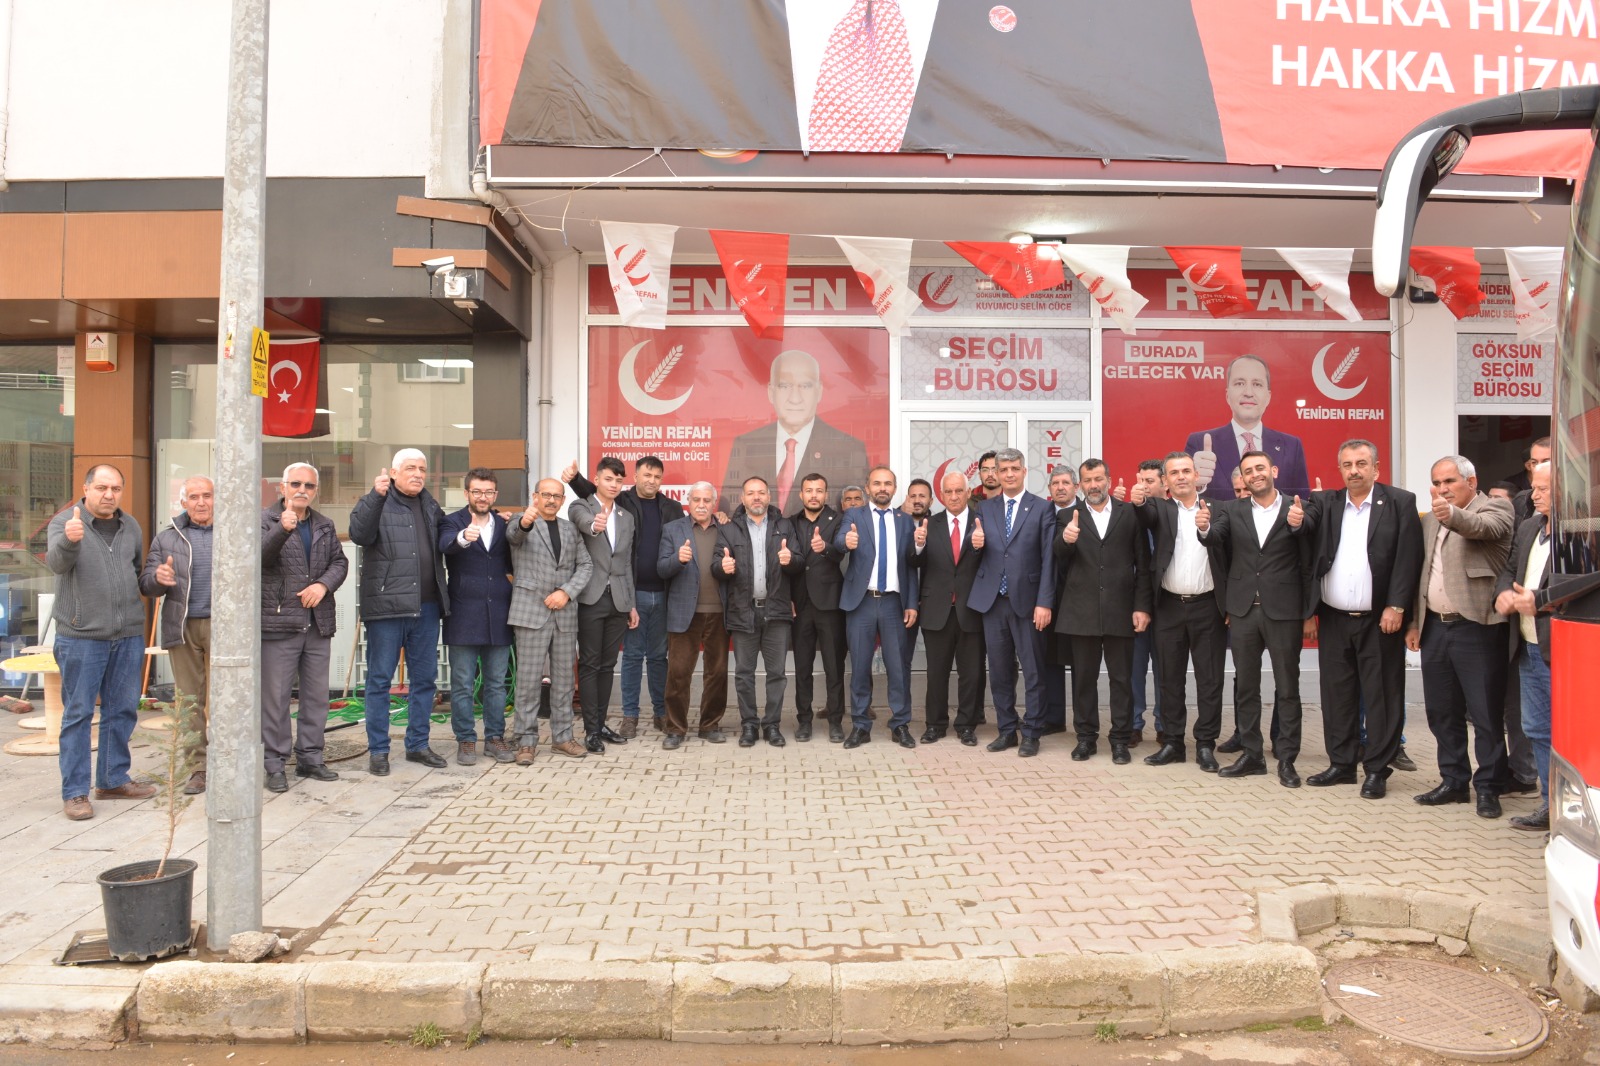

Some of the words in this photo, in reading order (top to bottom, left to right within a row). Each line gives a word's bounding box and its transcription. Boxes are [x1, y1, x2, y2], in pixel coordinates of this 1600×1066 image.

[1272, 44, 1455, 93] HAKKA
[976, 302, 1018, 311] KUYUMCU
[1021, 300, 1046, 311] SELİM
[1048, 300, 1072, 311] CÜCE
[949, 333, 1043, 366] SEÇİM
[1130, 345, 1198, 358] BURADA
[1472, 340, 1542, 359] GÖKSUN
[934, 363, 1058, 391] BÜROSU
[1104, 365, 1187, 379] GELECEK
[1190, 366, 1225, 379] VAR
[1481, 360, 1534, 381] SEÇİM
[1473, 379, 1542, 397] BÜROSU
[1296, 405, 1345, 420] YENİDEN
[1348, 408, 1384, 420] REFAH
[601, 423, 663, 439] YENİDEN
[667, 426, 712, 439] REFAH
[664, 441, 690, 449] BAŞKAN
[683, 450, 710, 461] CÜCE
